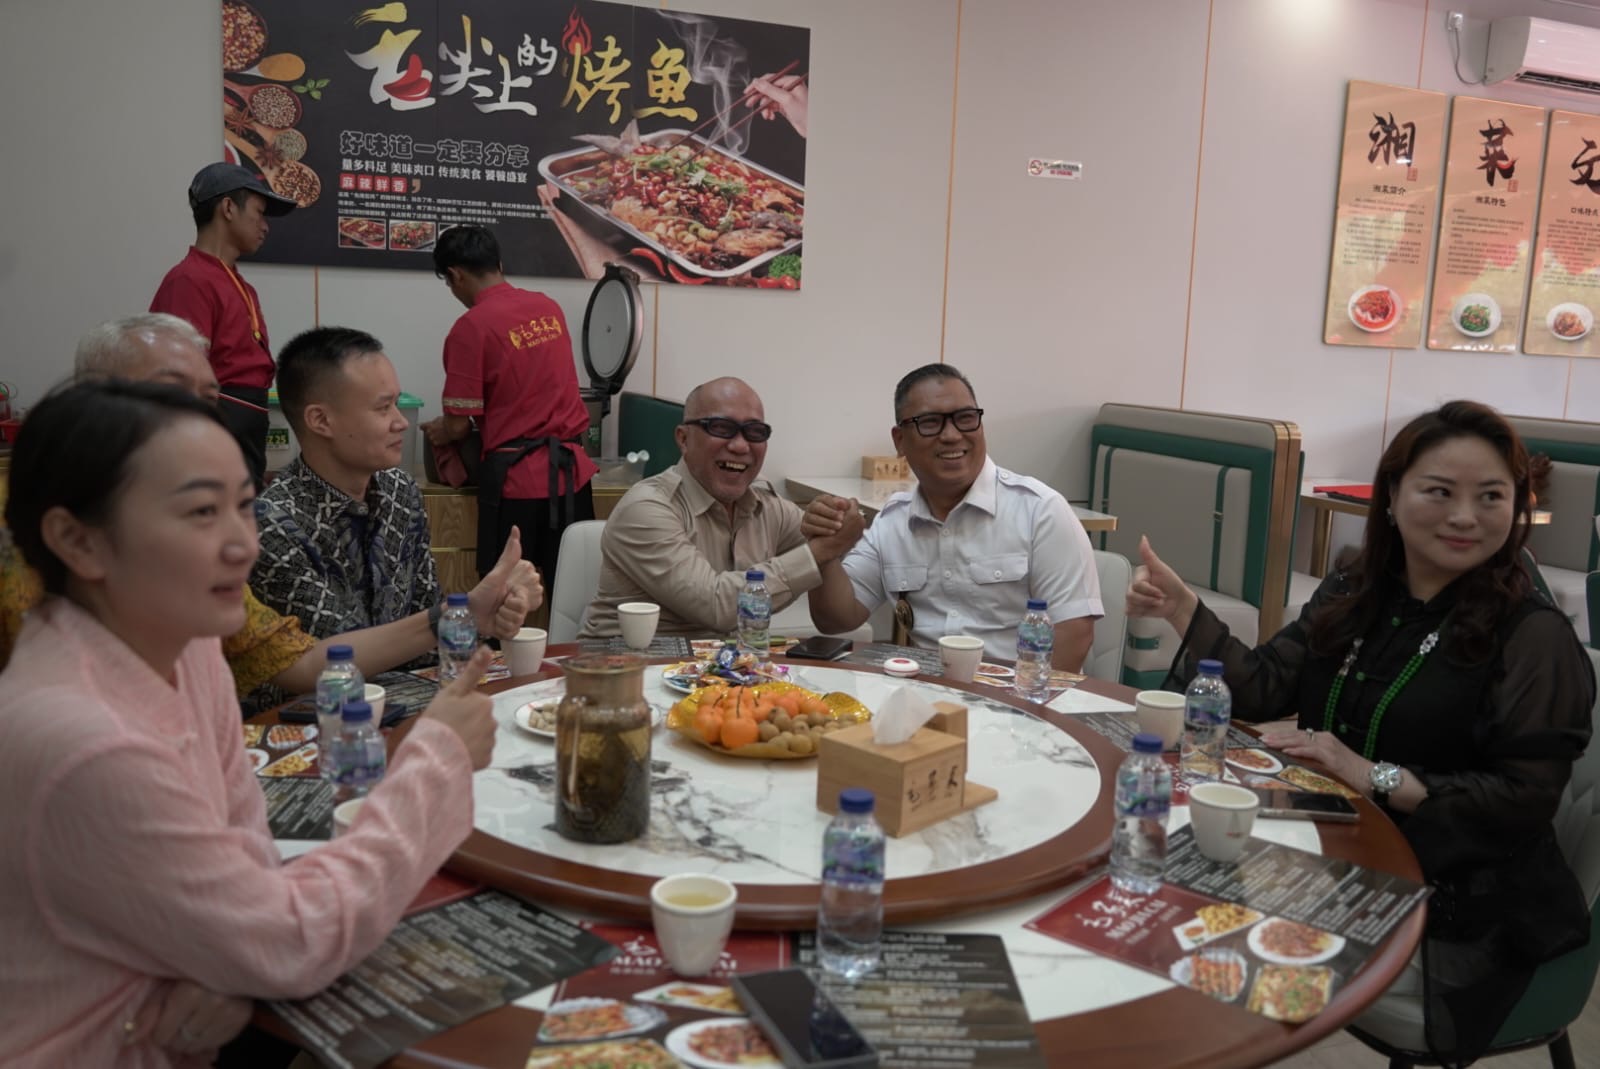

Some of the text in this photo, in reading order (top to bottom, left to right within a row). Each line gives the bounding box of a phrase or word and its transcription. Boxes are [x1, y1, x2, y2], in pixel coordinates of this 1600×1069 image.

[339, 130, 530, 168] 好味道一定要分享
[1367, 112, 1416, 167] 湘
[1475, 118, 1518, 187] 菜
[1569, 137, 1600, 196] 文
[341, 158, 387, 174] 量多料足
[391, 162, 434, 177] 美味爽口
[438, 167, 481, 181] 传统美食
